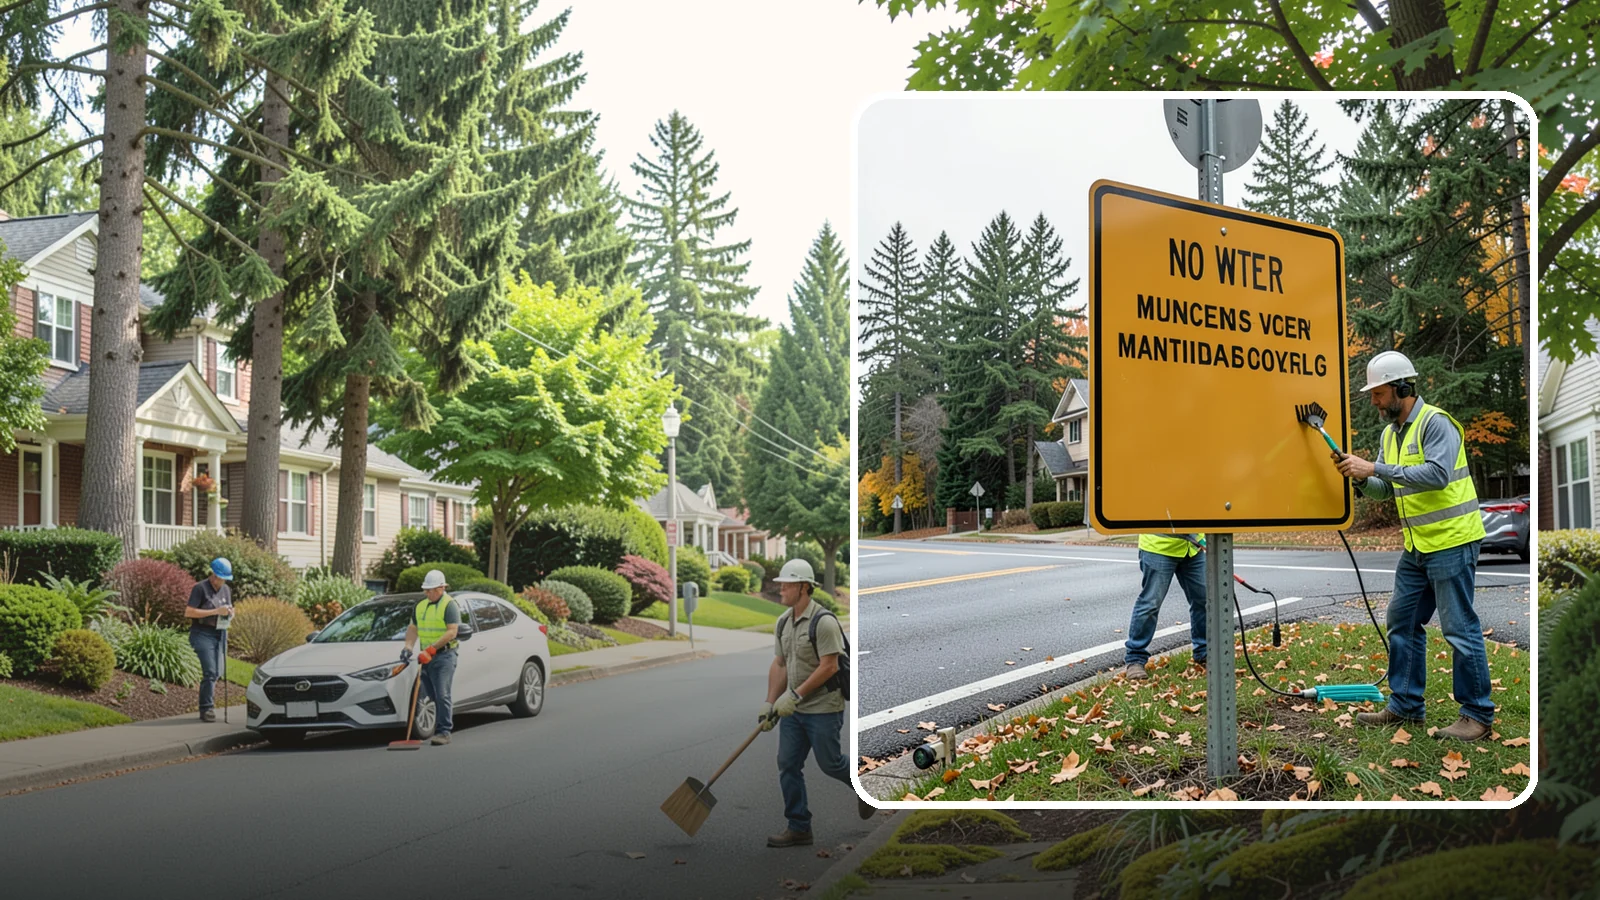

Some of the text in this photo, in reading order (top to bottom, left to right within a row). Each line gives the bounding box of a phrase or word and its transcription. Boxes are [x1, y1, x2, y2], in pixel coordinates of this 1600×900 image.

[1169, 237, 1284, 295] NO WTER
[1137, 293, 1252, 333] MUNCENS
